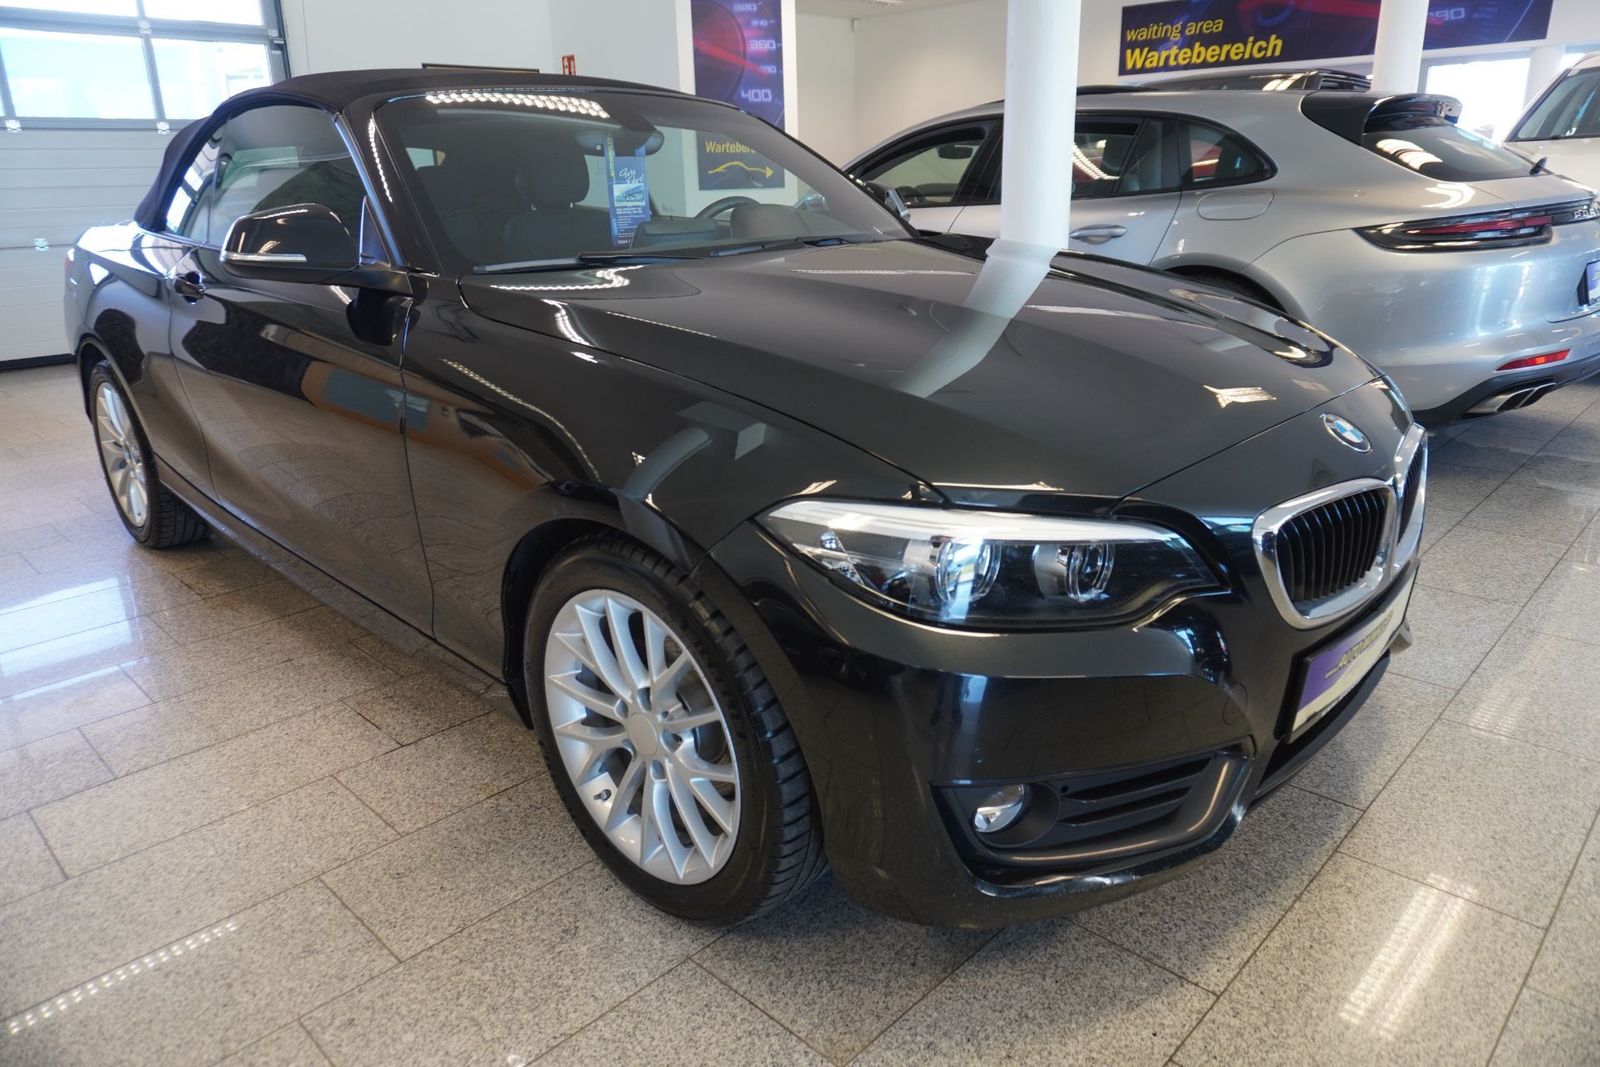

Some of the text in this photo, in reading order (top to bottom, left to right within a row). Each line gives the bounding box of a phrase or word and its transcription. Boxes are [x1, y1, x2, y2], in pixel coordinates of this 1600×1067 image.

[1127, 18, 1224, 42] waiting area
[749, 40, 776, 50] 360
[1125, 34, 1283, 70] Wartebereich
[741, 89, 772, 102] 400
